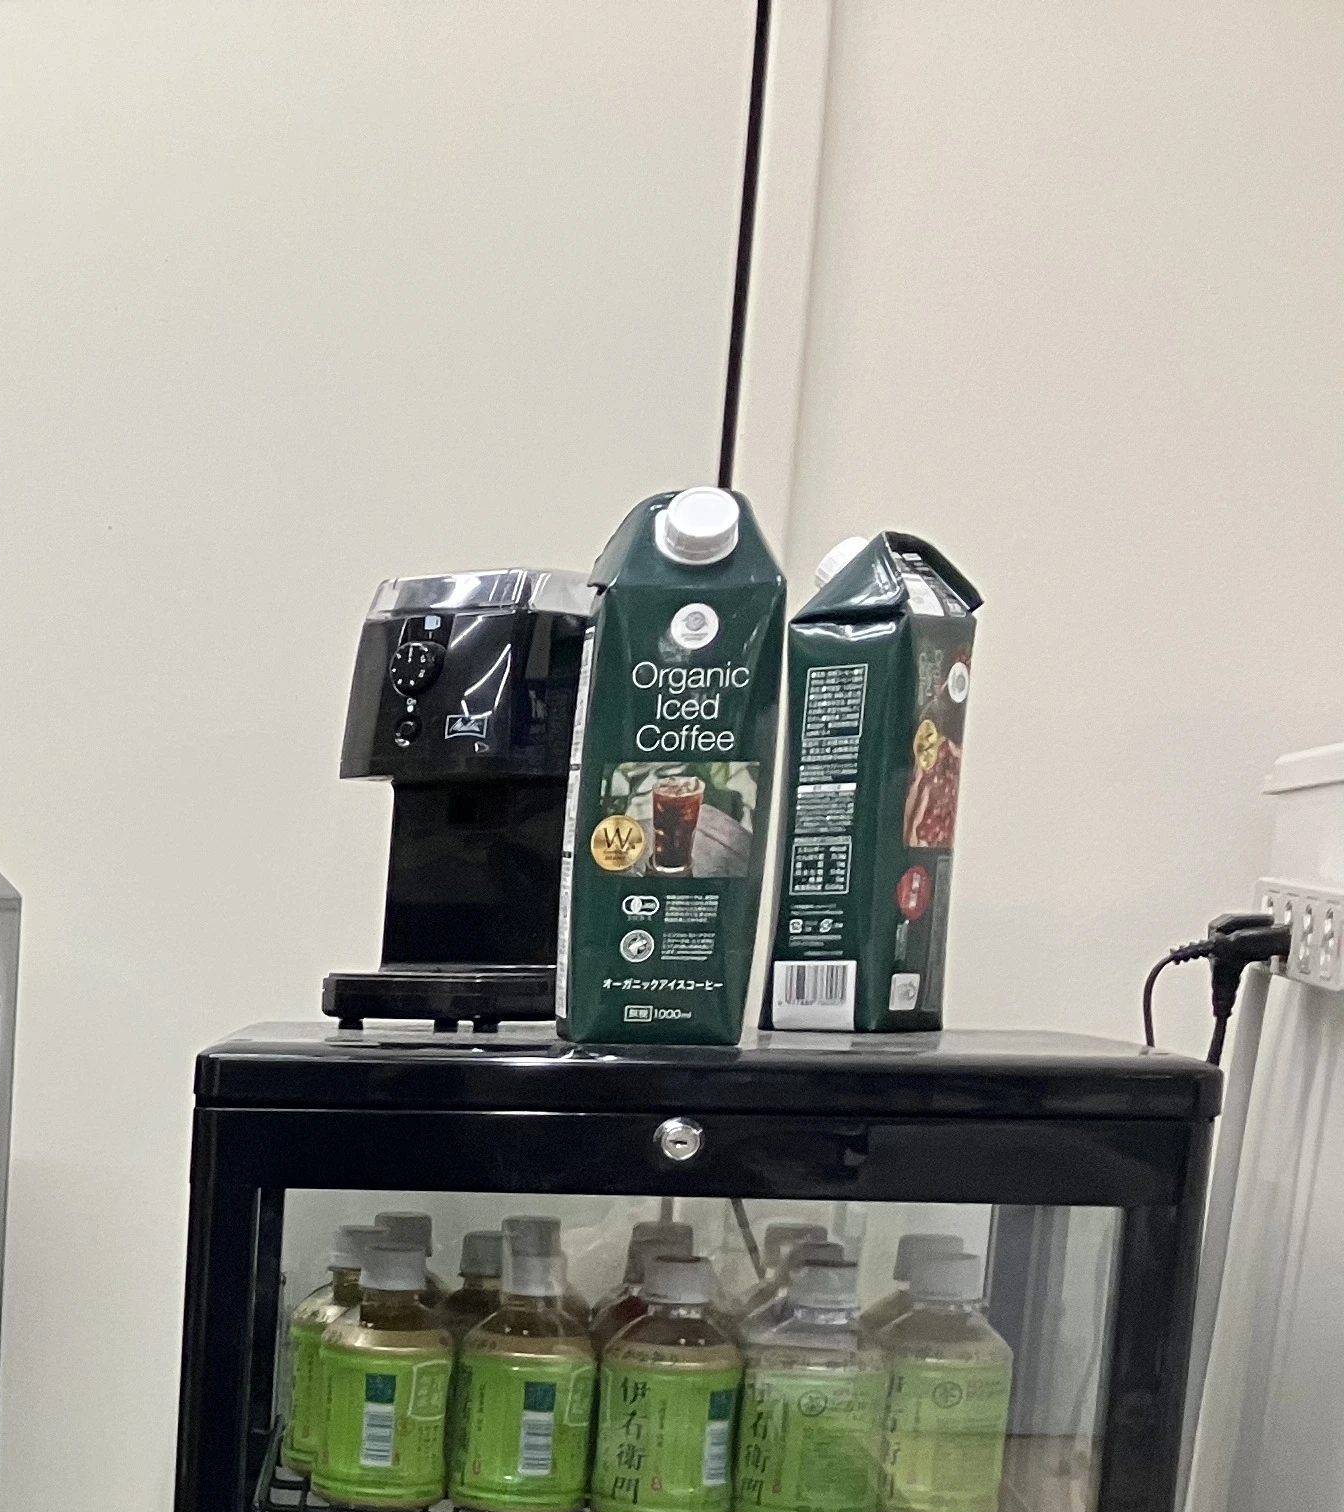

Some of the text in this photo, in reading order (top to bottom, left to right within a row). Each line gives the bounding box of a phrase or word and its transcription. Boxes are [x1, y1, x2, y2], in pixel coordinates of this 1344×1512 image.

[632, 661, 750, 695] Organic
[655, 693, 720, 721] Iced
[635, 723, 736, 752] Coffee
[602, 826, 634, 850] W
[602, 977, 724, 991] オーガニックアイスコーヒー
[611, 1375, 650, 1505] 伊右衛門
